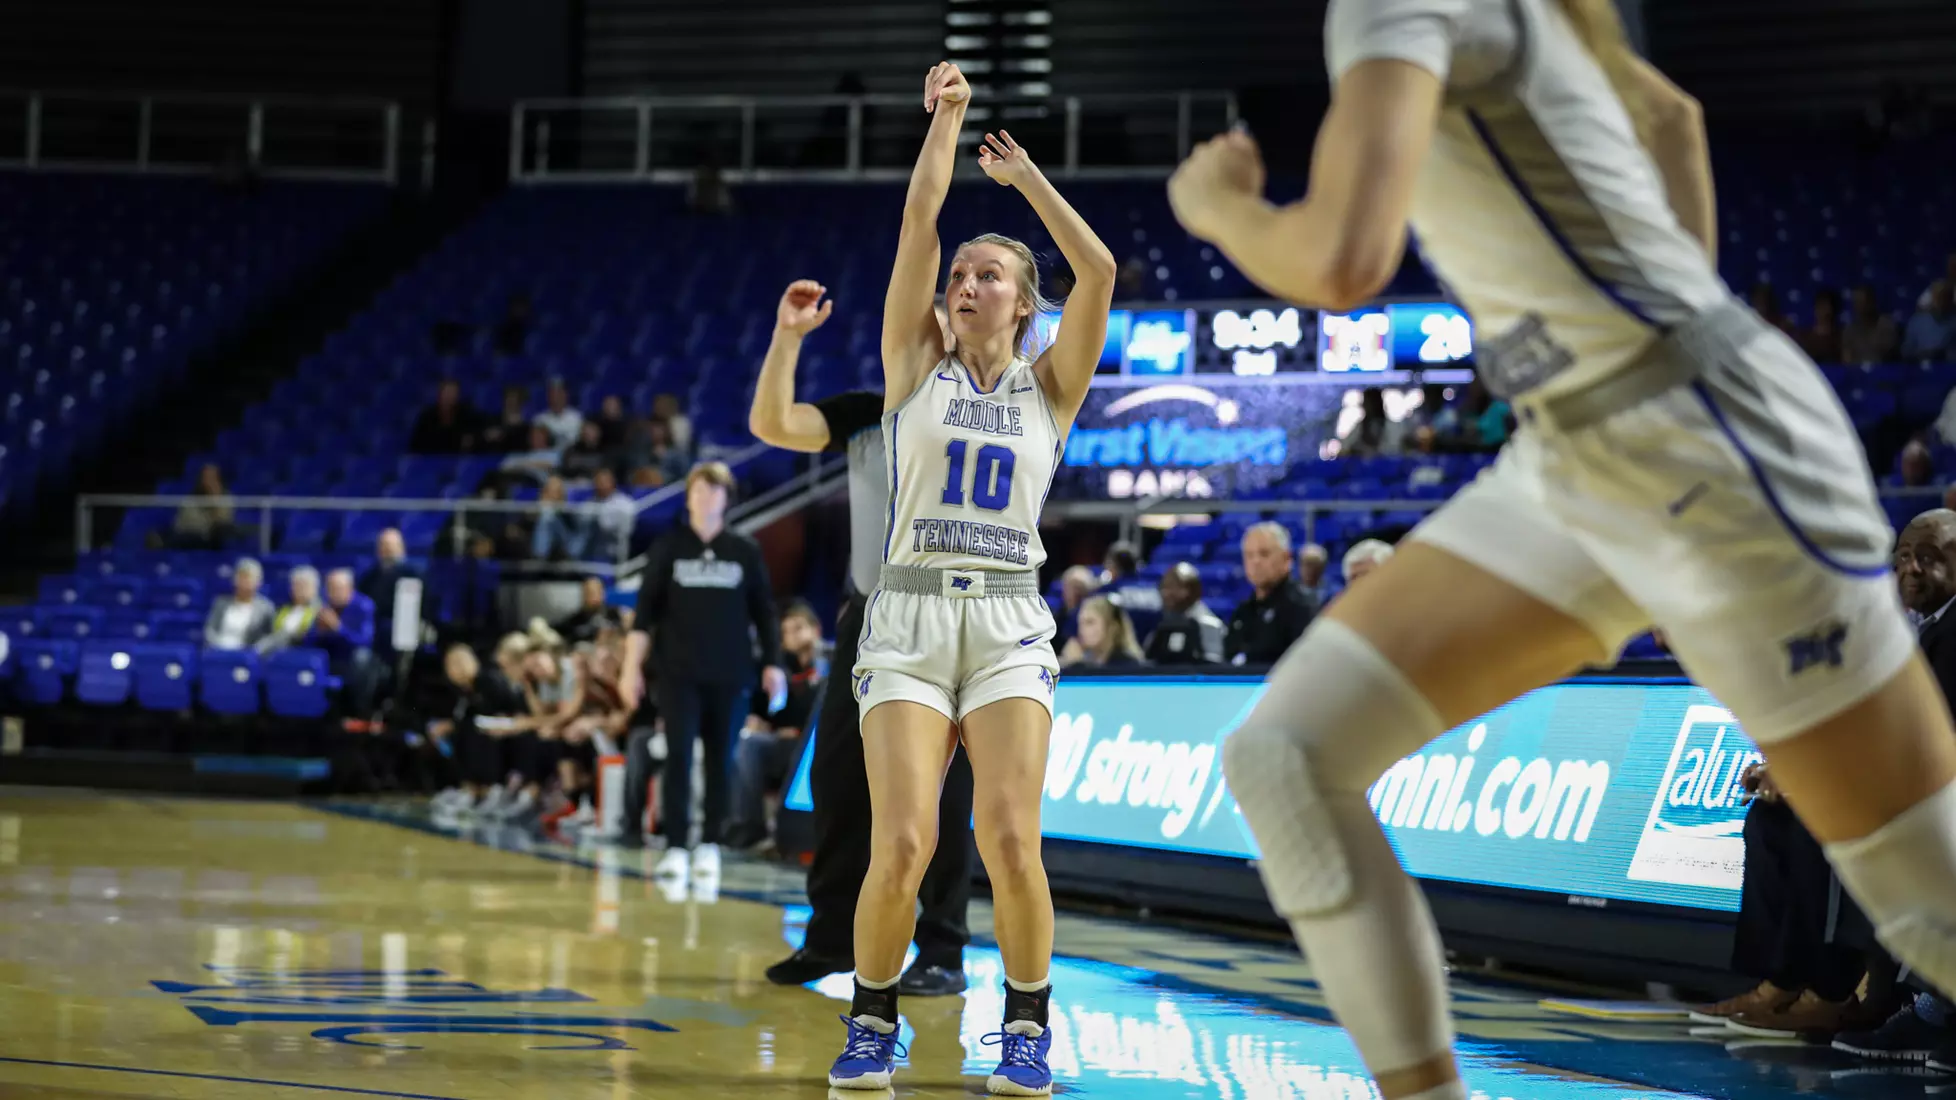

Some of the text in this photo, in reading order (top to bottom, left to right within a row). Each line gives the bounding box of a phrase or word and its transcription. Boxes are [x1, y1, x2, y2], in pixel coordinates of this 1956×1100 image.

[943, 398, 1024, 437] MIDDLE
[940, 437, 1017, 514] 10
[912, 518, 1030, 566] TENNESSEE
[1075, 723, 1217, 838] strong
